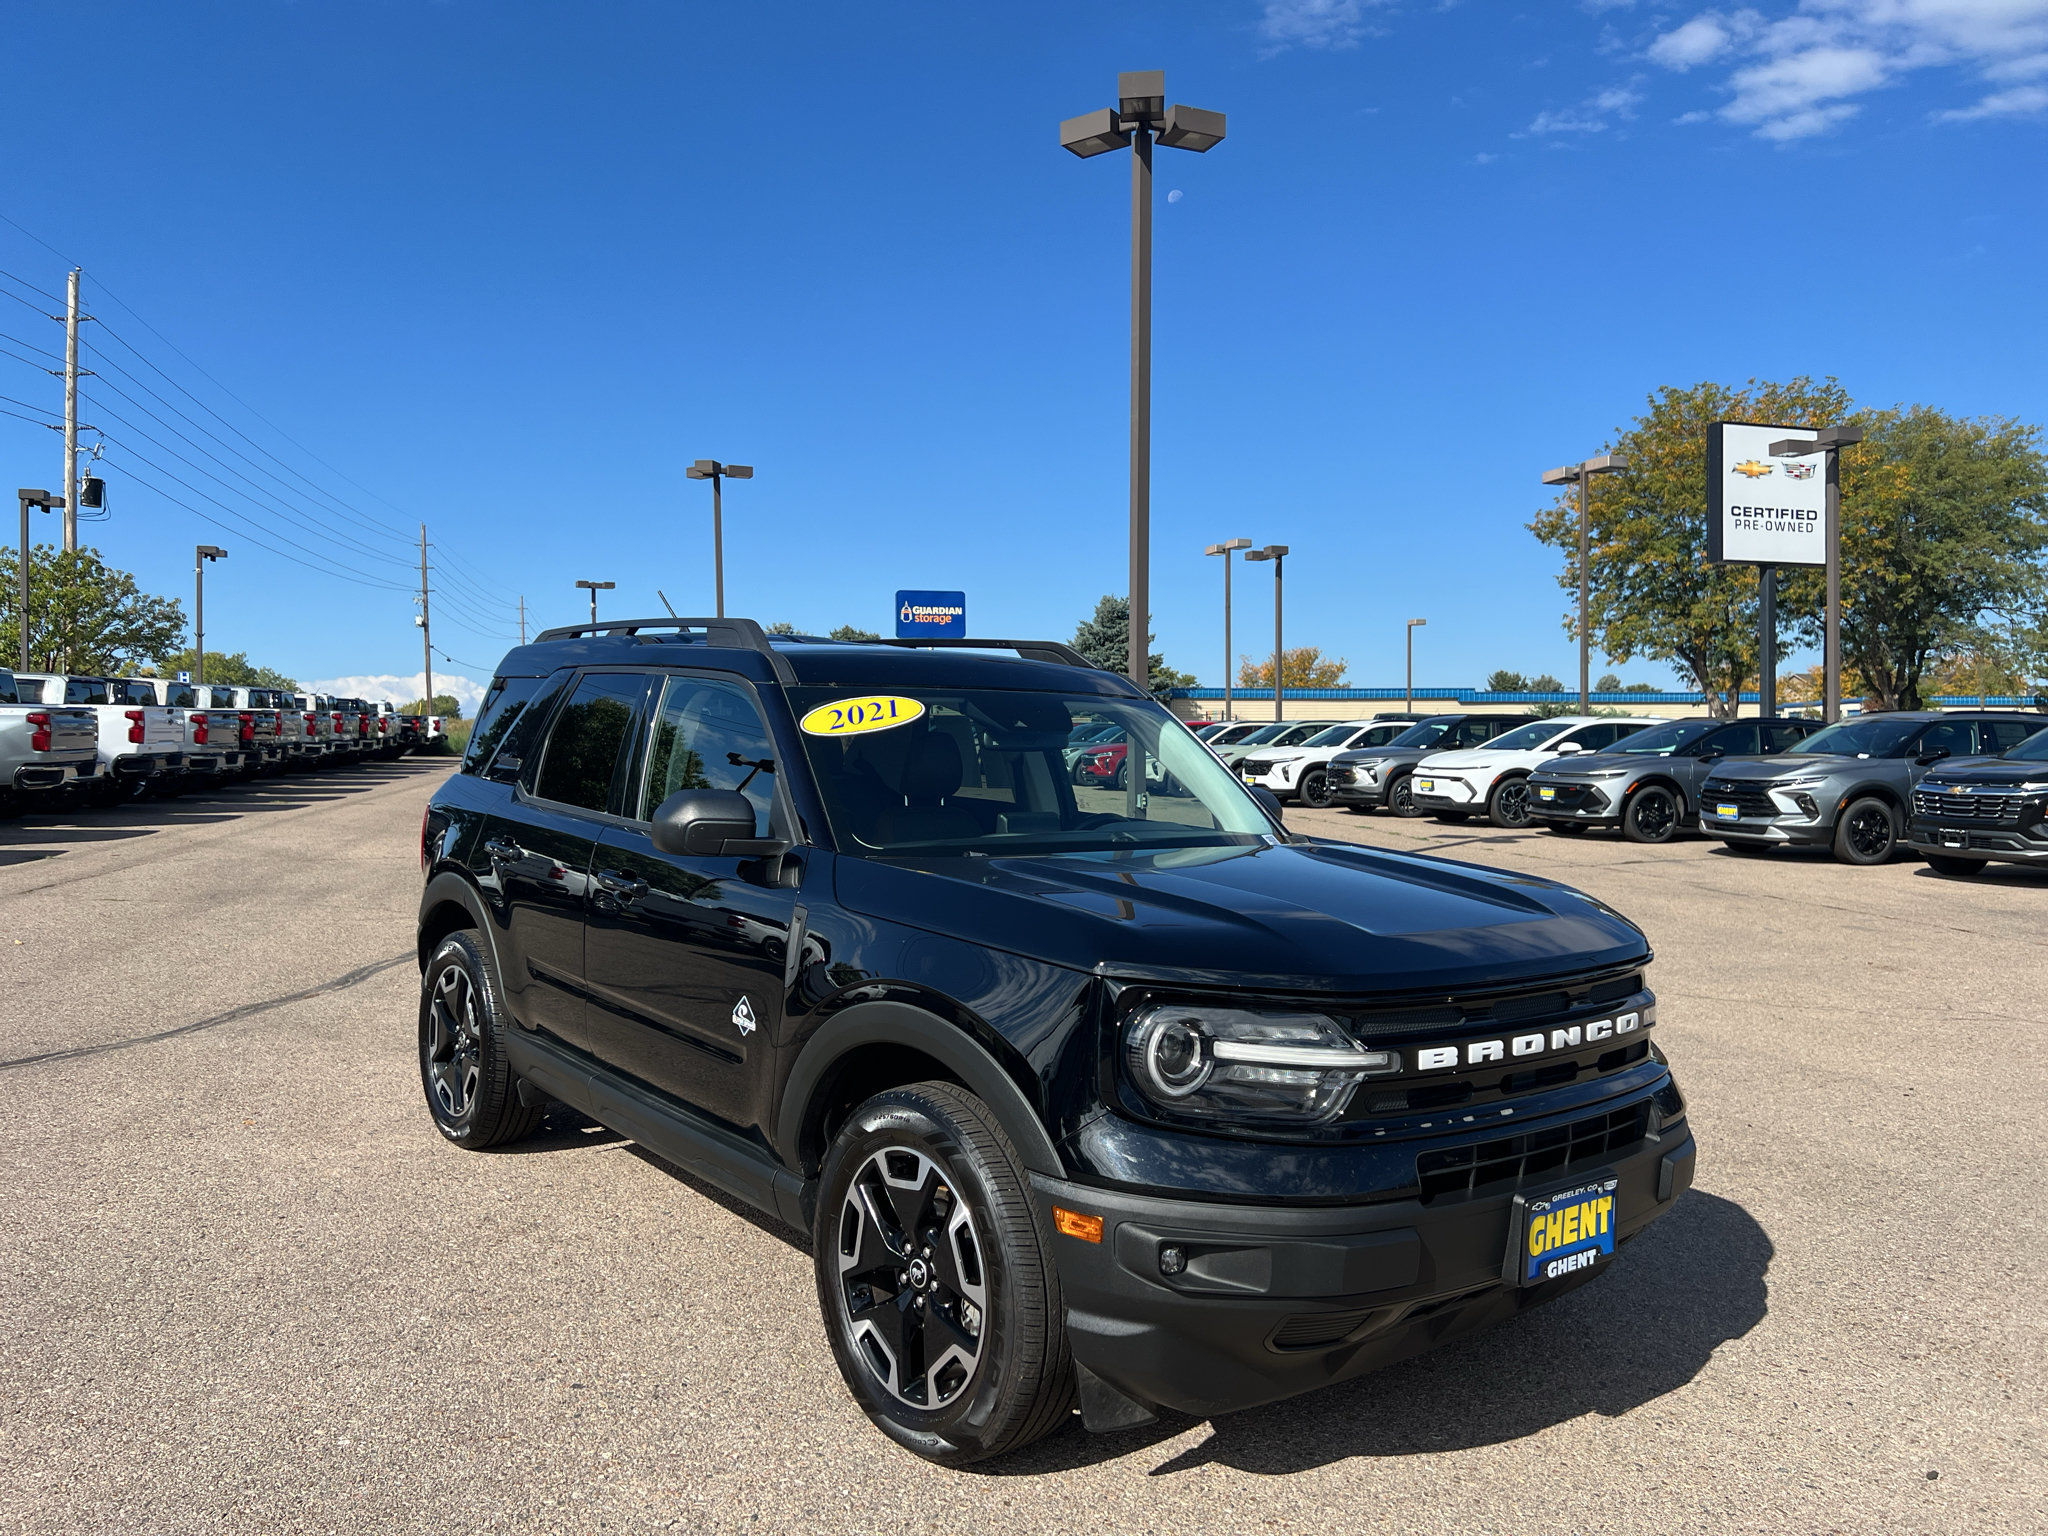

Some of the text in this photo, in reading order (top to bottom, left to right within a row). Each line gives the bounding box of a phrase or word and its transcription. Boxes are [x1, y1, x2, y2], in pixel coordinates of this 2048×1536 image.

[1731, 505, 1818, 521] CERTIFIED
[1735, 519, 1814, 533] PRE-OWNED
[912, 605, 963, 615] GUARDIAN
[914, 614, 952, 625] storage
[827, 699, 899, 730] 2021
[1417, 1012, 1639, 1071] BRONCO
[1551, 1183, 1598, 1202] GREELEY, CO
[1529, 1195, 1613, 1257] GHENT
[1547, 1248, 1597, 1278] GHENT
